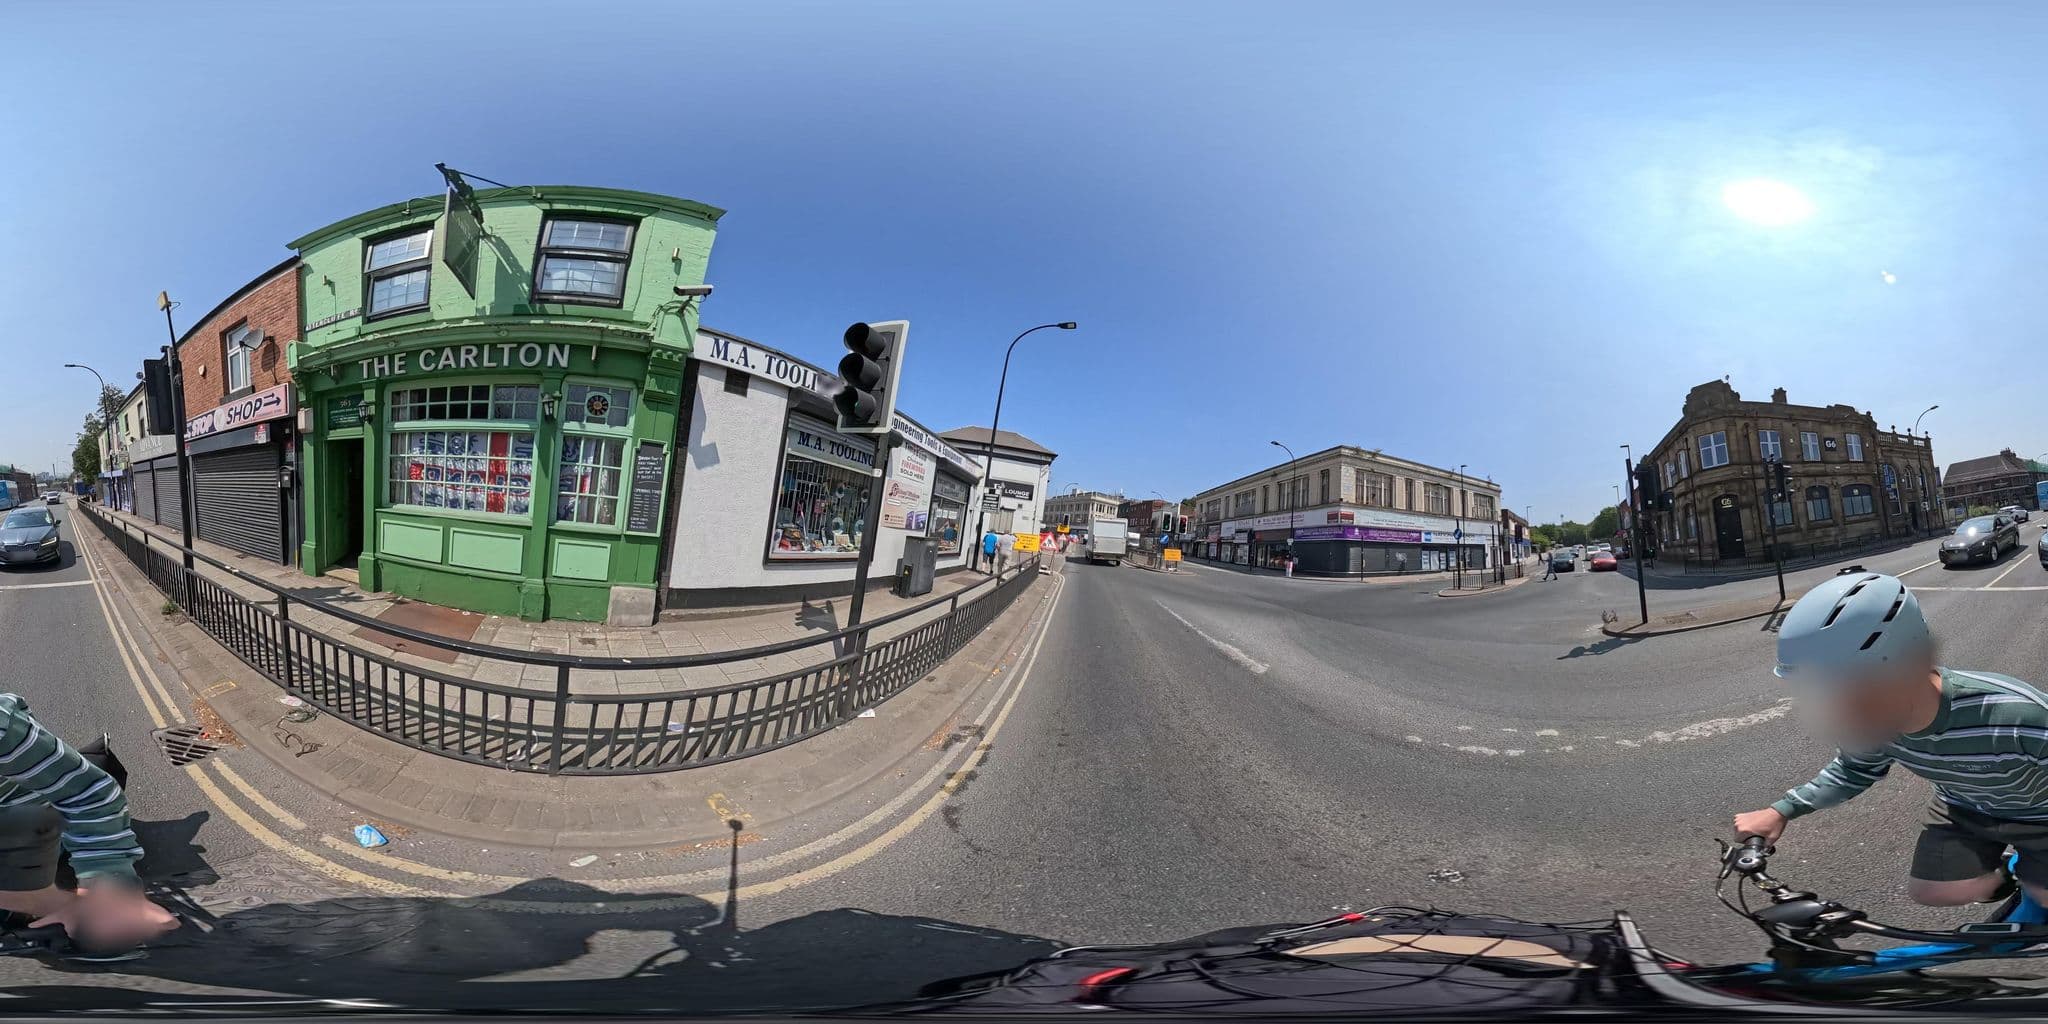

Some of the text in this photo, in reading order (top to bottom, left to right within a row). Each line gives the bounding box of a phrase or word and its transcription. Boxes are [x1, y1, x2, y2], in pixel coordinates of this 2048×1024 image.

[358, 343, 570, 379] THE CARLTON
[710, 338, 818, 391] M.A. TOOLI
[192, 414, 214, 437] STOP
[226, 397, 263, 425] SHOP
[797, 431, 826, 451] M.A.
[1825, 440, 1836, 448] G6
[900, 468, 914, 477] SOLD
[1004, 488, 1030, 497] LOUNGE
